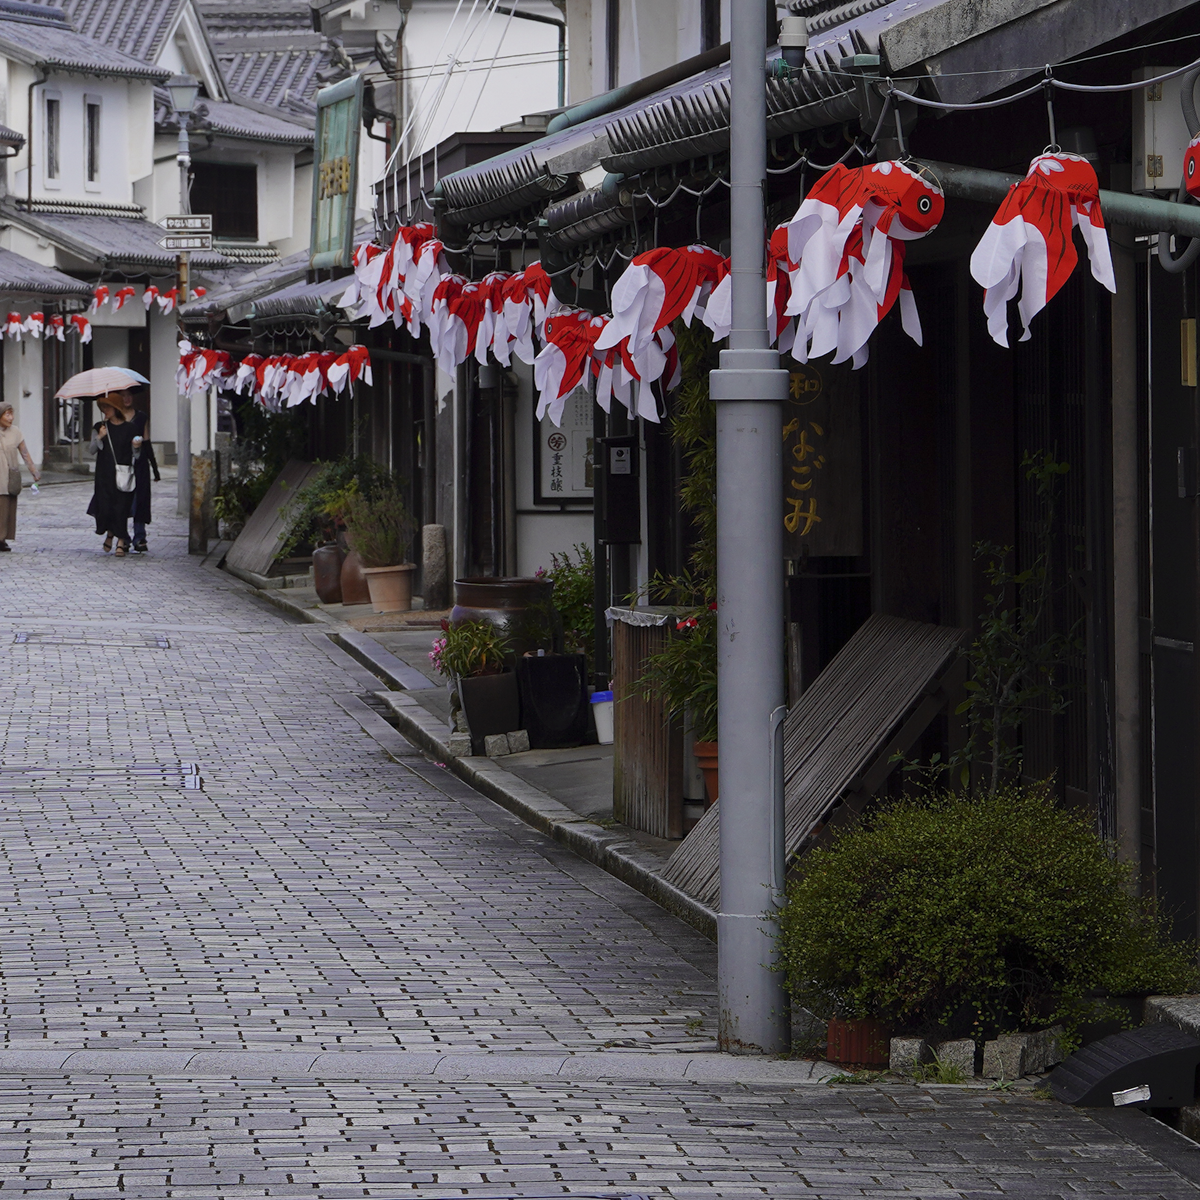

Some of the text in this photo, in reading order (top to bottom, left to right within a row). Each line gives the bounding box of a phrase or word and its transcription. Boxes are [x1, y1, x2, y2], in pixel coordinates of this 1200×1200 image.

[789, 370, 820, 401] 和
[783, 417, 826, 536] なごみ
